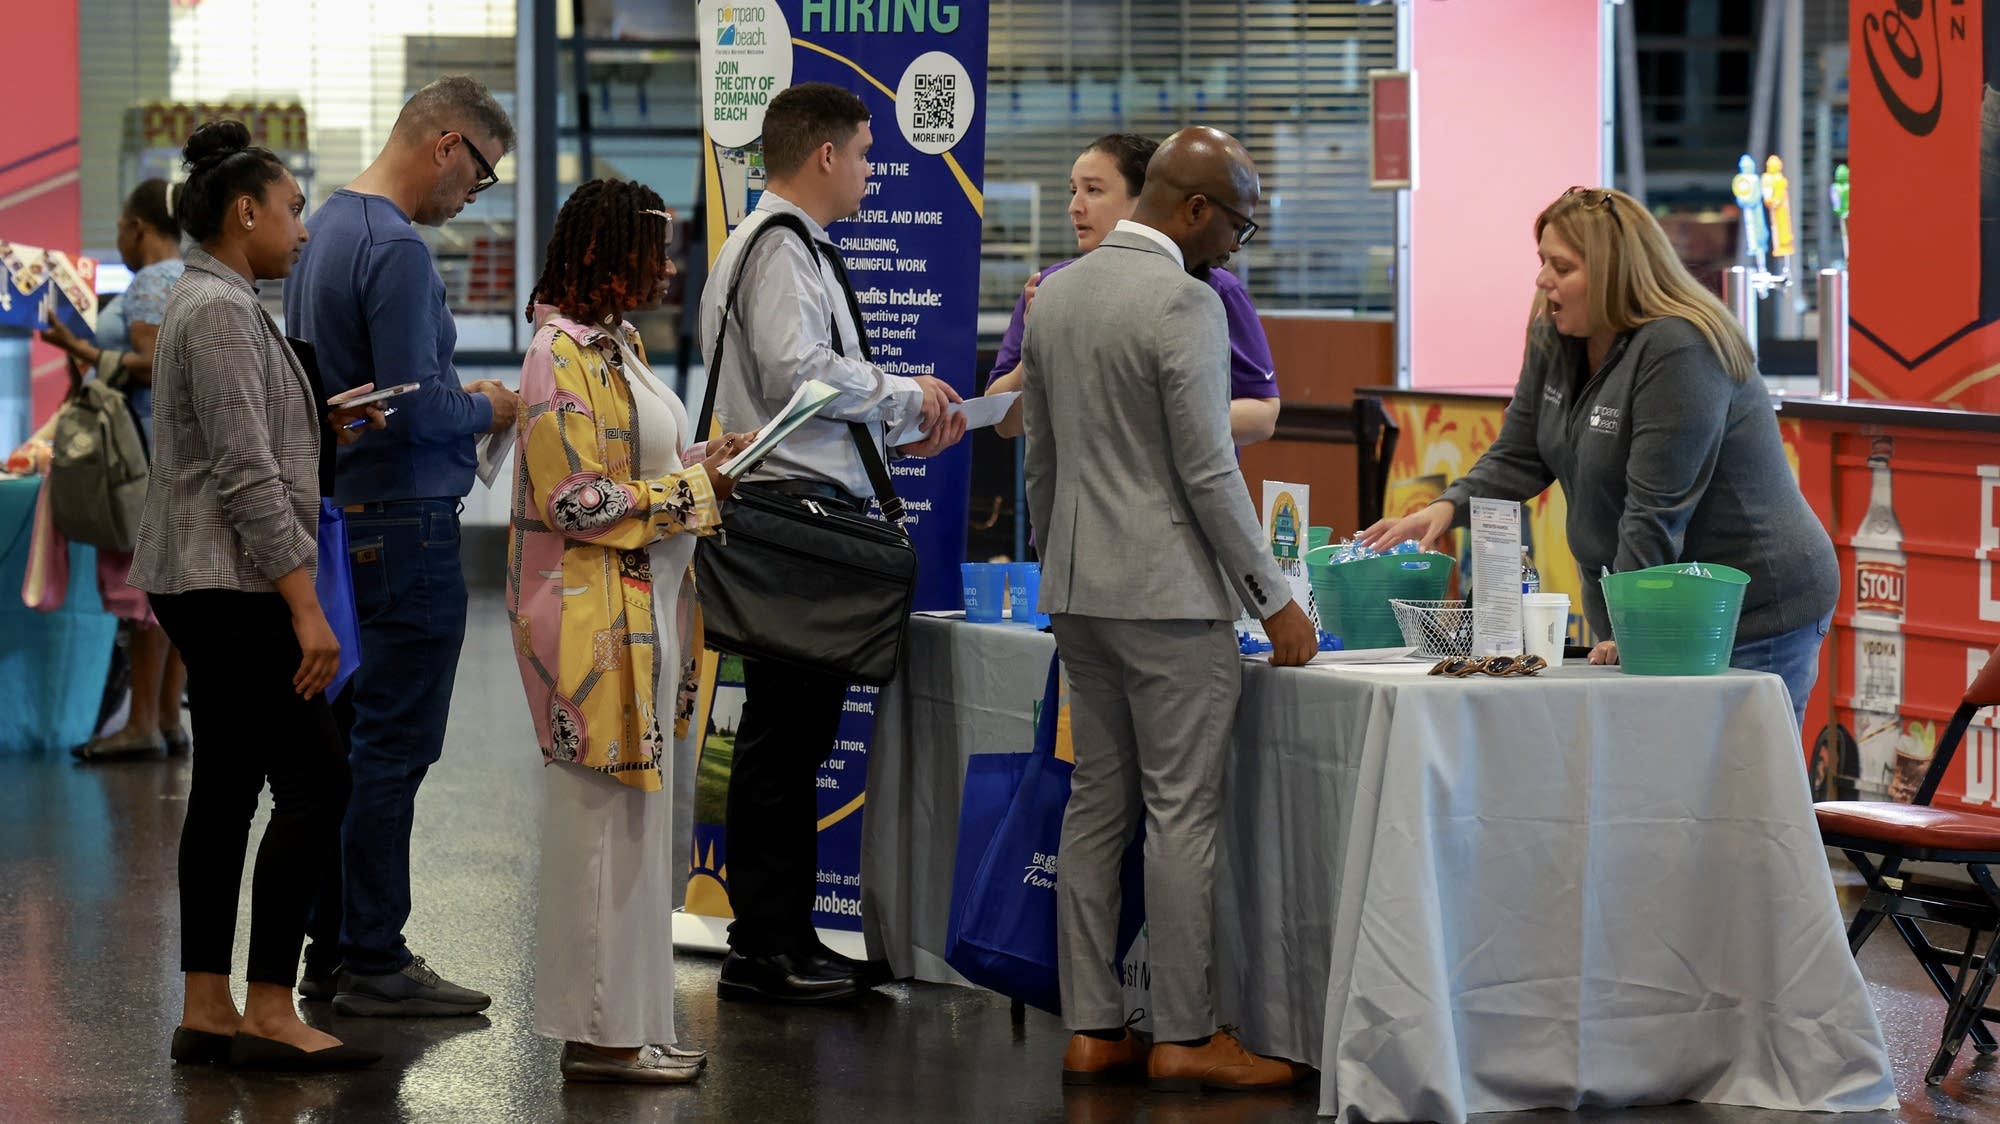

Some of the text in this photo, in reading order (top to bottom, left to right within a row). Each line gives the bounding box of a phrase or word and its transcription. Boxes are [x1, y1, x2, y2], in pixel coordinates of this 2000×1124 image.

[717, 5, 765, 25] pompano
[801, 0, 960, 34] HIRING
[714, 61, 739, 75] JOIN
[714, 76, 775, 90] THE CITY OF
[714, 91, 768, 106] POMPANO
[714, 107, 748, 121] BEACH
[912, 132, 955, 143] MORE INFO
[877, 162, 888, 175] IN
[889, 162, 910, 176] THE
[890, 210, 912, 224] AND
[914, 211, 943, 225] MORE
[840, 237, 899, 254] CHALLENGING,
[896, 258, 927, 272] WORK
[889, 288, 942, 307] Include:
[901, 312, 920, 326] pay
[882, 327, 917, 340] Benefit
[881, 344, 902, 356] Plan
[1859, 570, 1901, 602] STOLI
[1862, 640, 1897, 657] VODKA
[841, 740, 867, 754] more,
[829, 759, 846, 770] our
[843, 873, 860, 887] and
